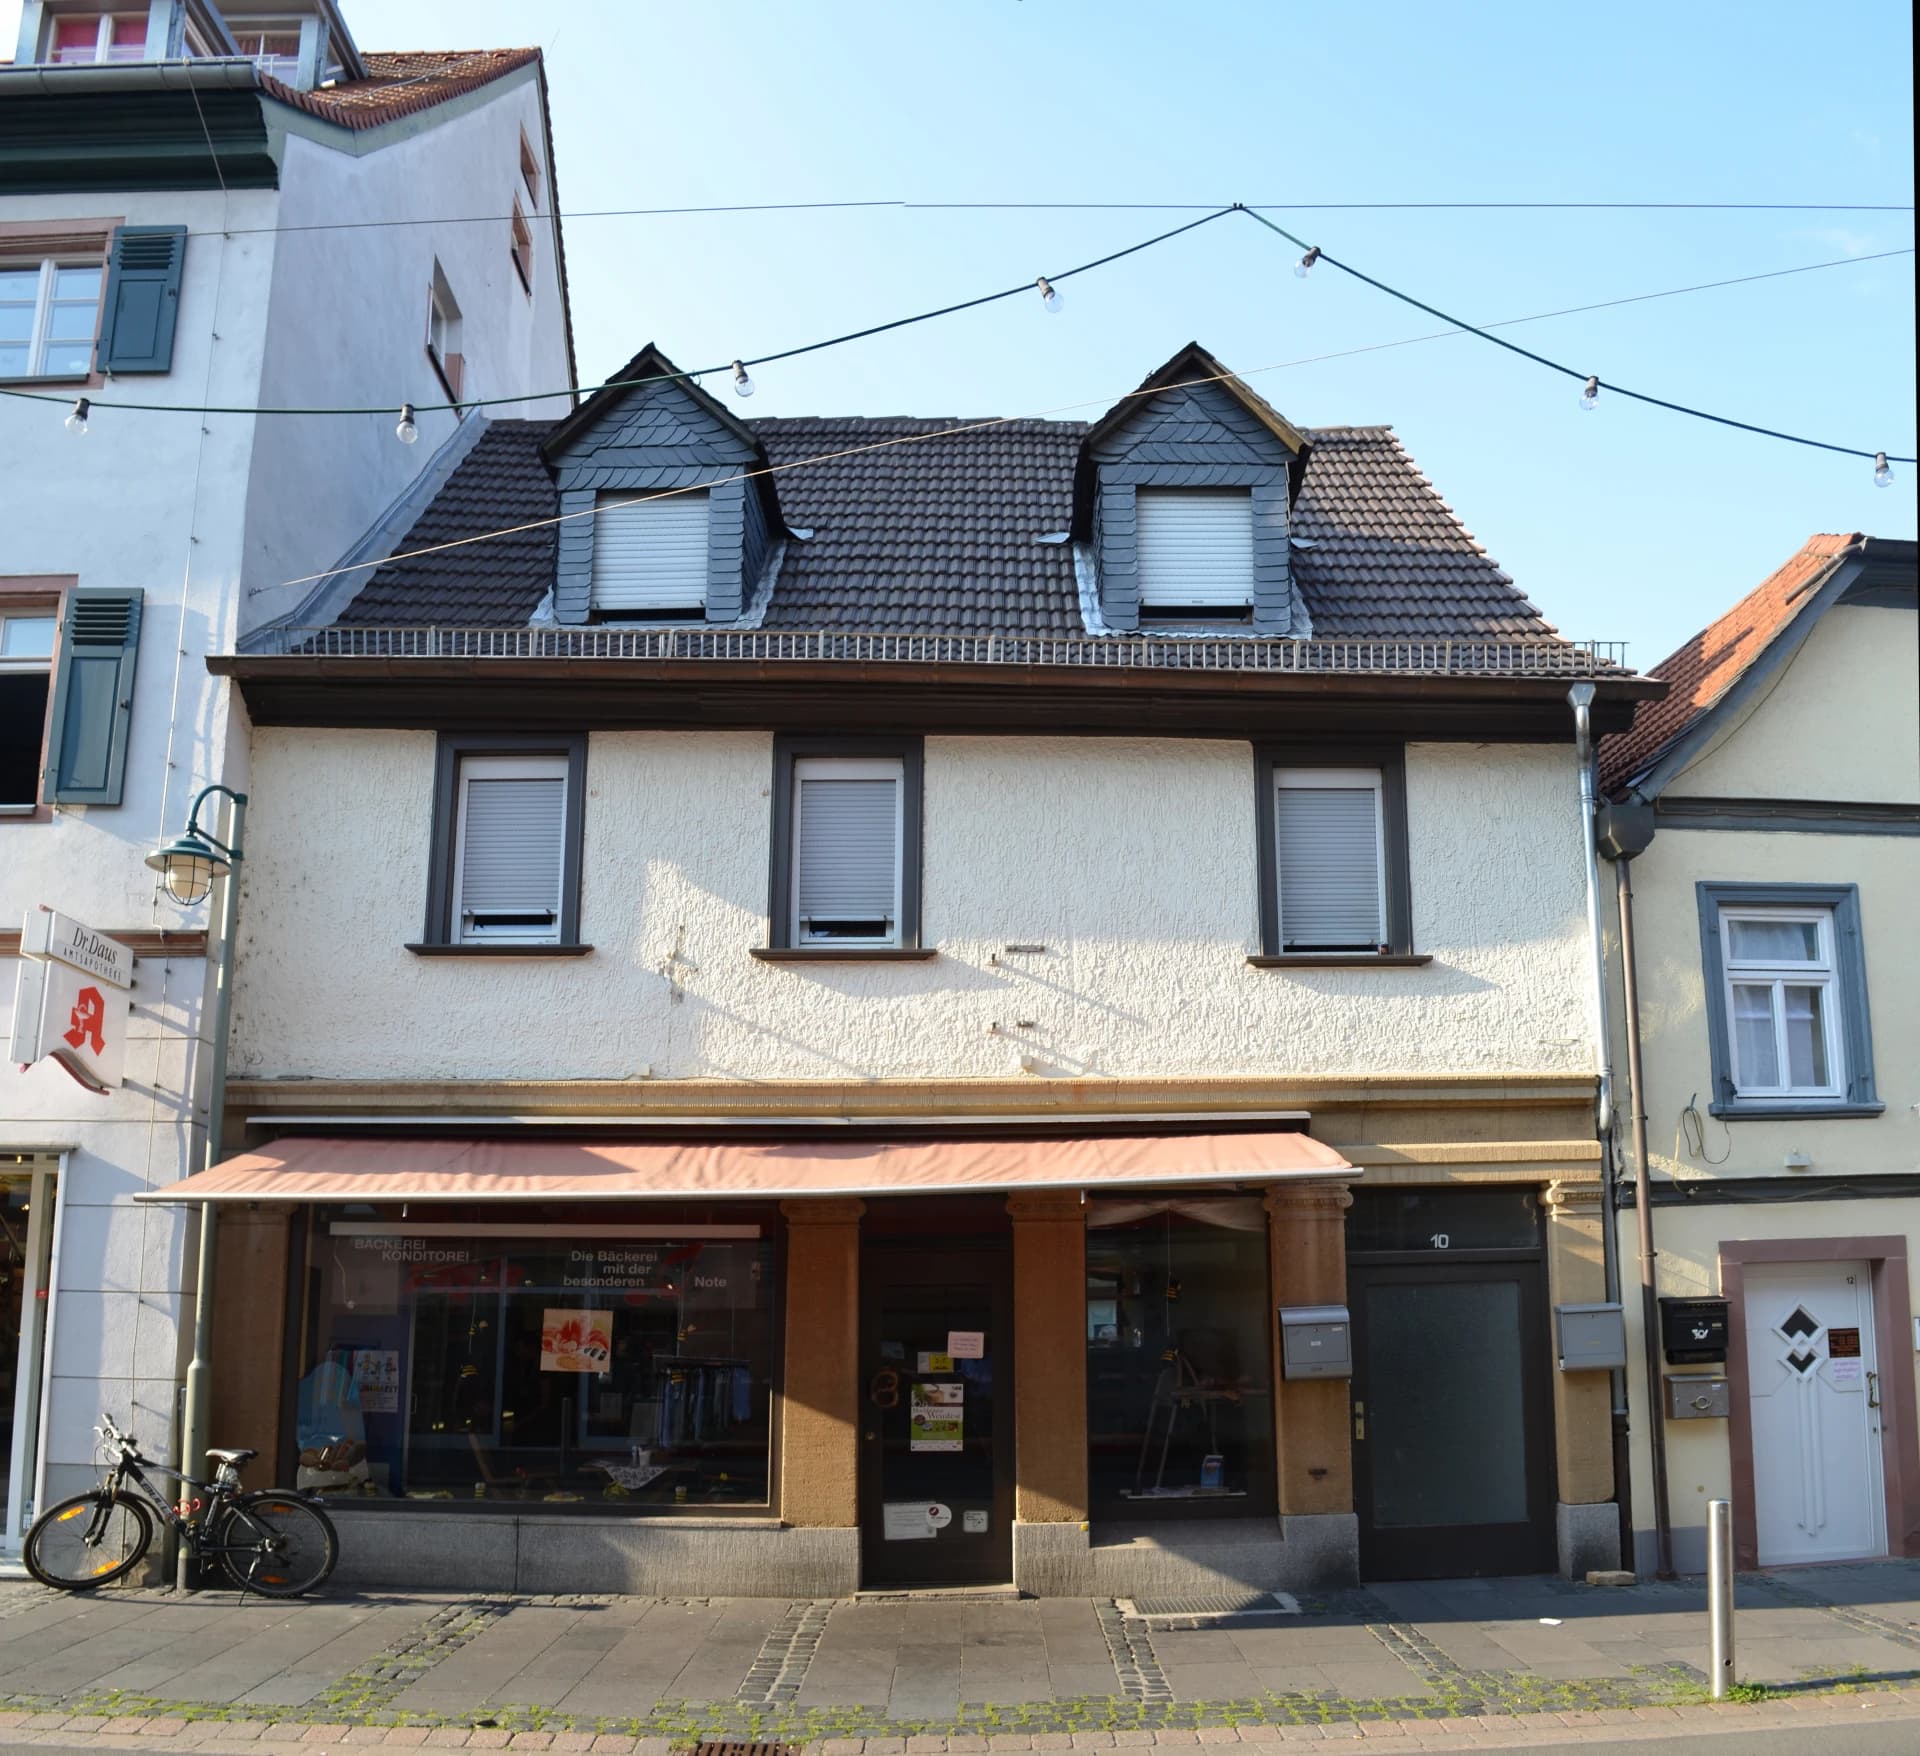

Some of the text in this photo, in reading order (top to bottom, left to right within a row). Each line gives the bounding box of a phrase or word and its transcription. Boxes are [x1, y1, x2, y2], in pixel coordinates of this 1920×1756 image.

[63, 946, 121, 981] AMTSAPOTHEKE
[1430, 1233, 1449, 1249] 10
[381, 1250, 470, 1262] KONDITOREI
[571, 1250, 658, 1261] Die Bäckerei
[602, 1264, 652, 1274] mit der
[563, 1275, 727, 1287] besonderen Note
